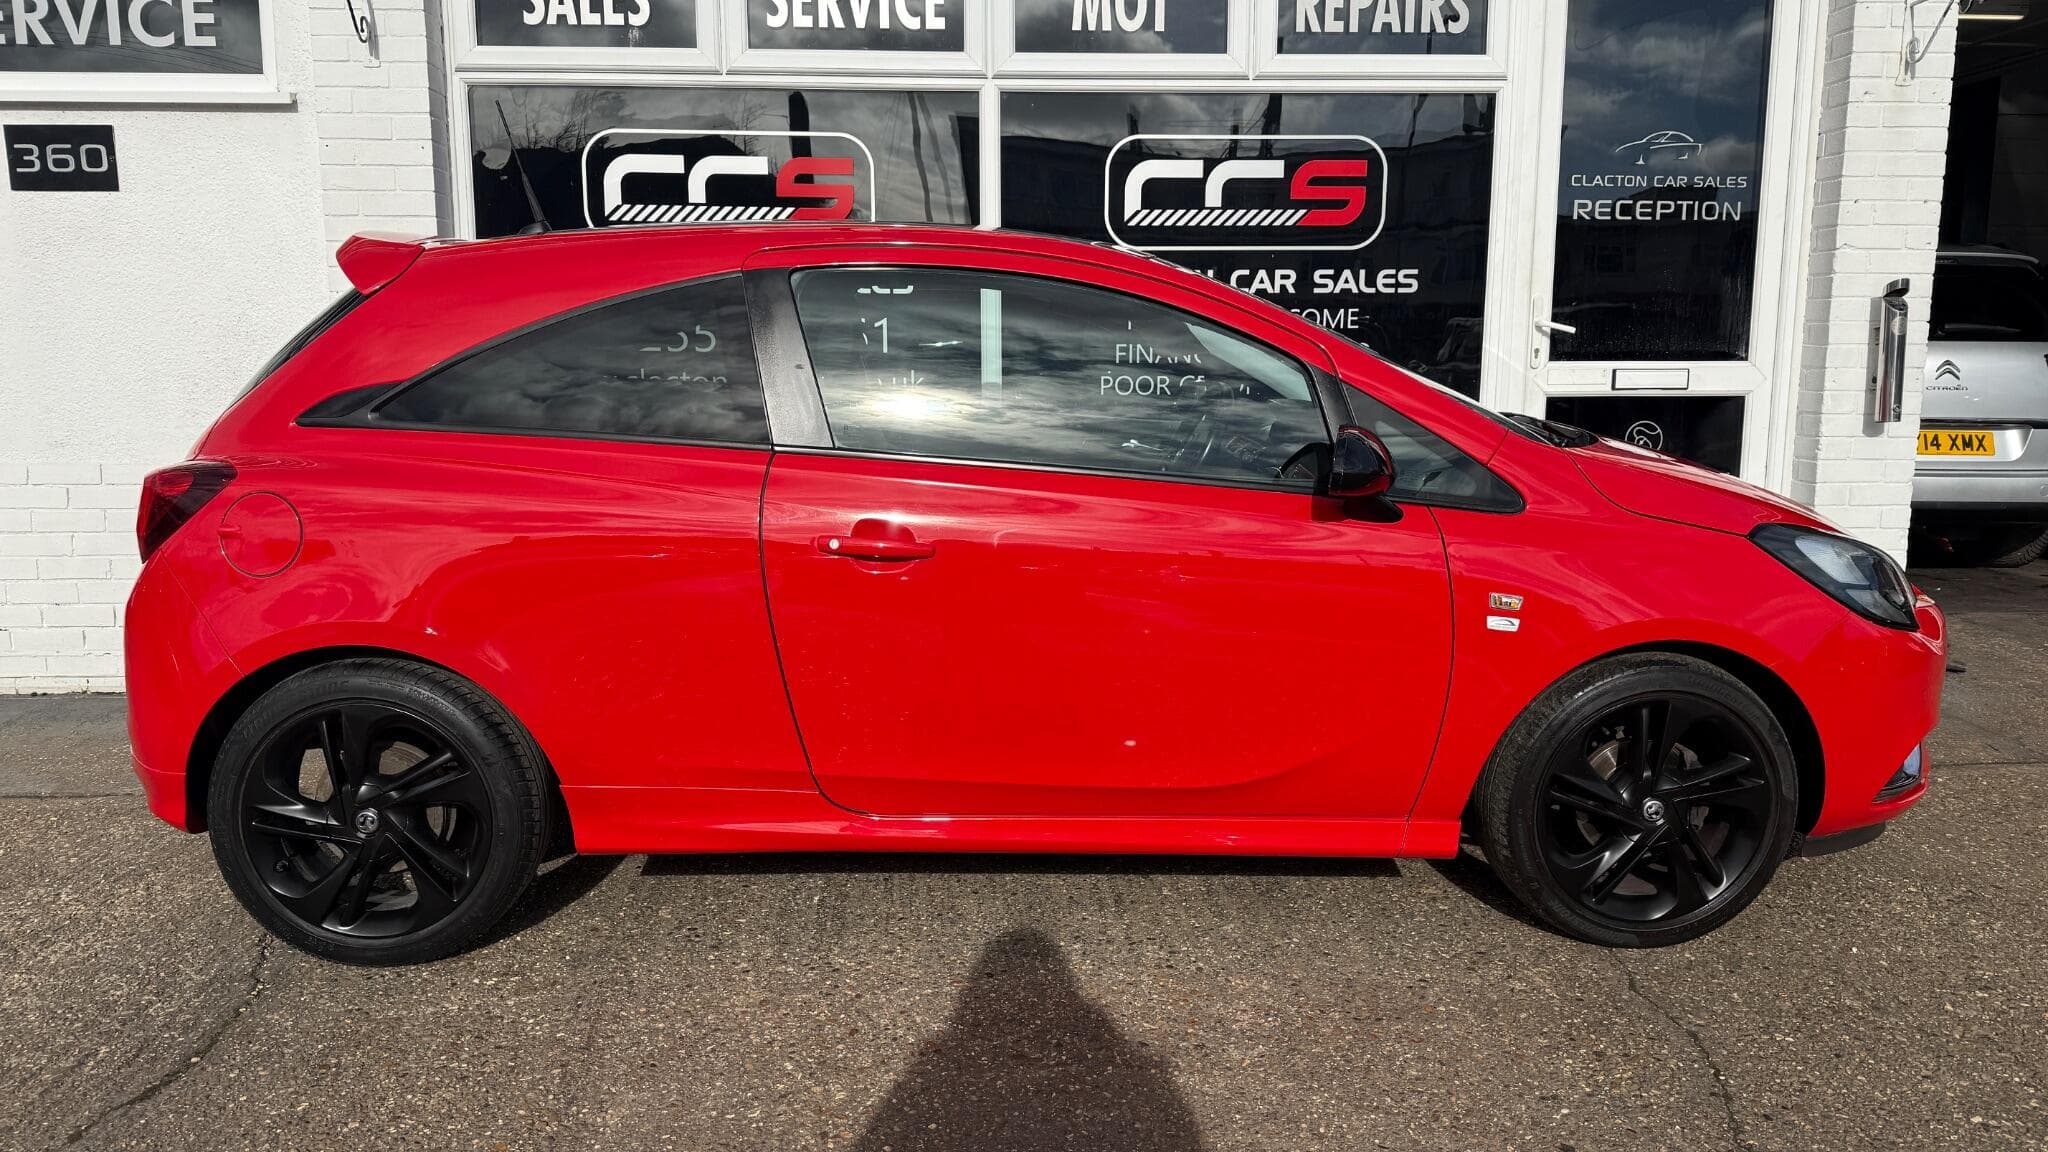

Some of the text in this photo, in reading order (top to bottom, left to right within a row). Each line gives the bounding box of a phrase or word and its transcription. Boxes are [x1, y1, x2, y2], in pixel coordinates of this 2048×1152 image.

[0, 0, 216, 47] RVICE
[14, 143, 109, 173] 360
[1571, 174, 1747, 188] CLACTON CAR SALES
[1572, 199, 1742, 221] RECEPTION
[1230, 269, 1419, 294] CAR SALES
[1100, 375, 1171, 395] POOR
[1917, 433, 1987, 452] 14 XMX
